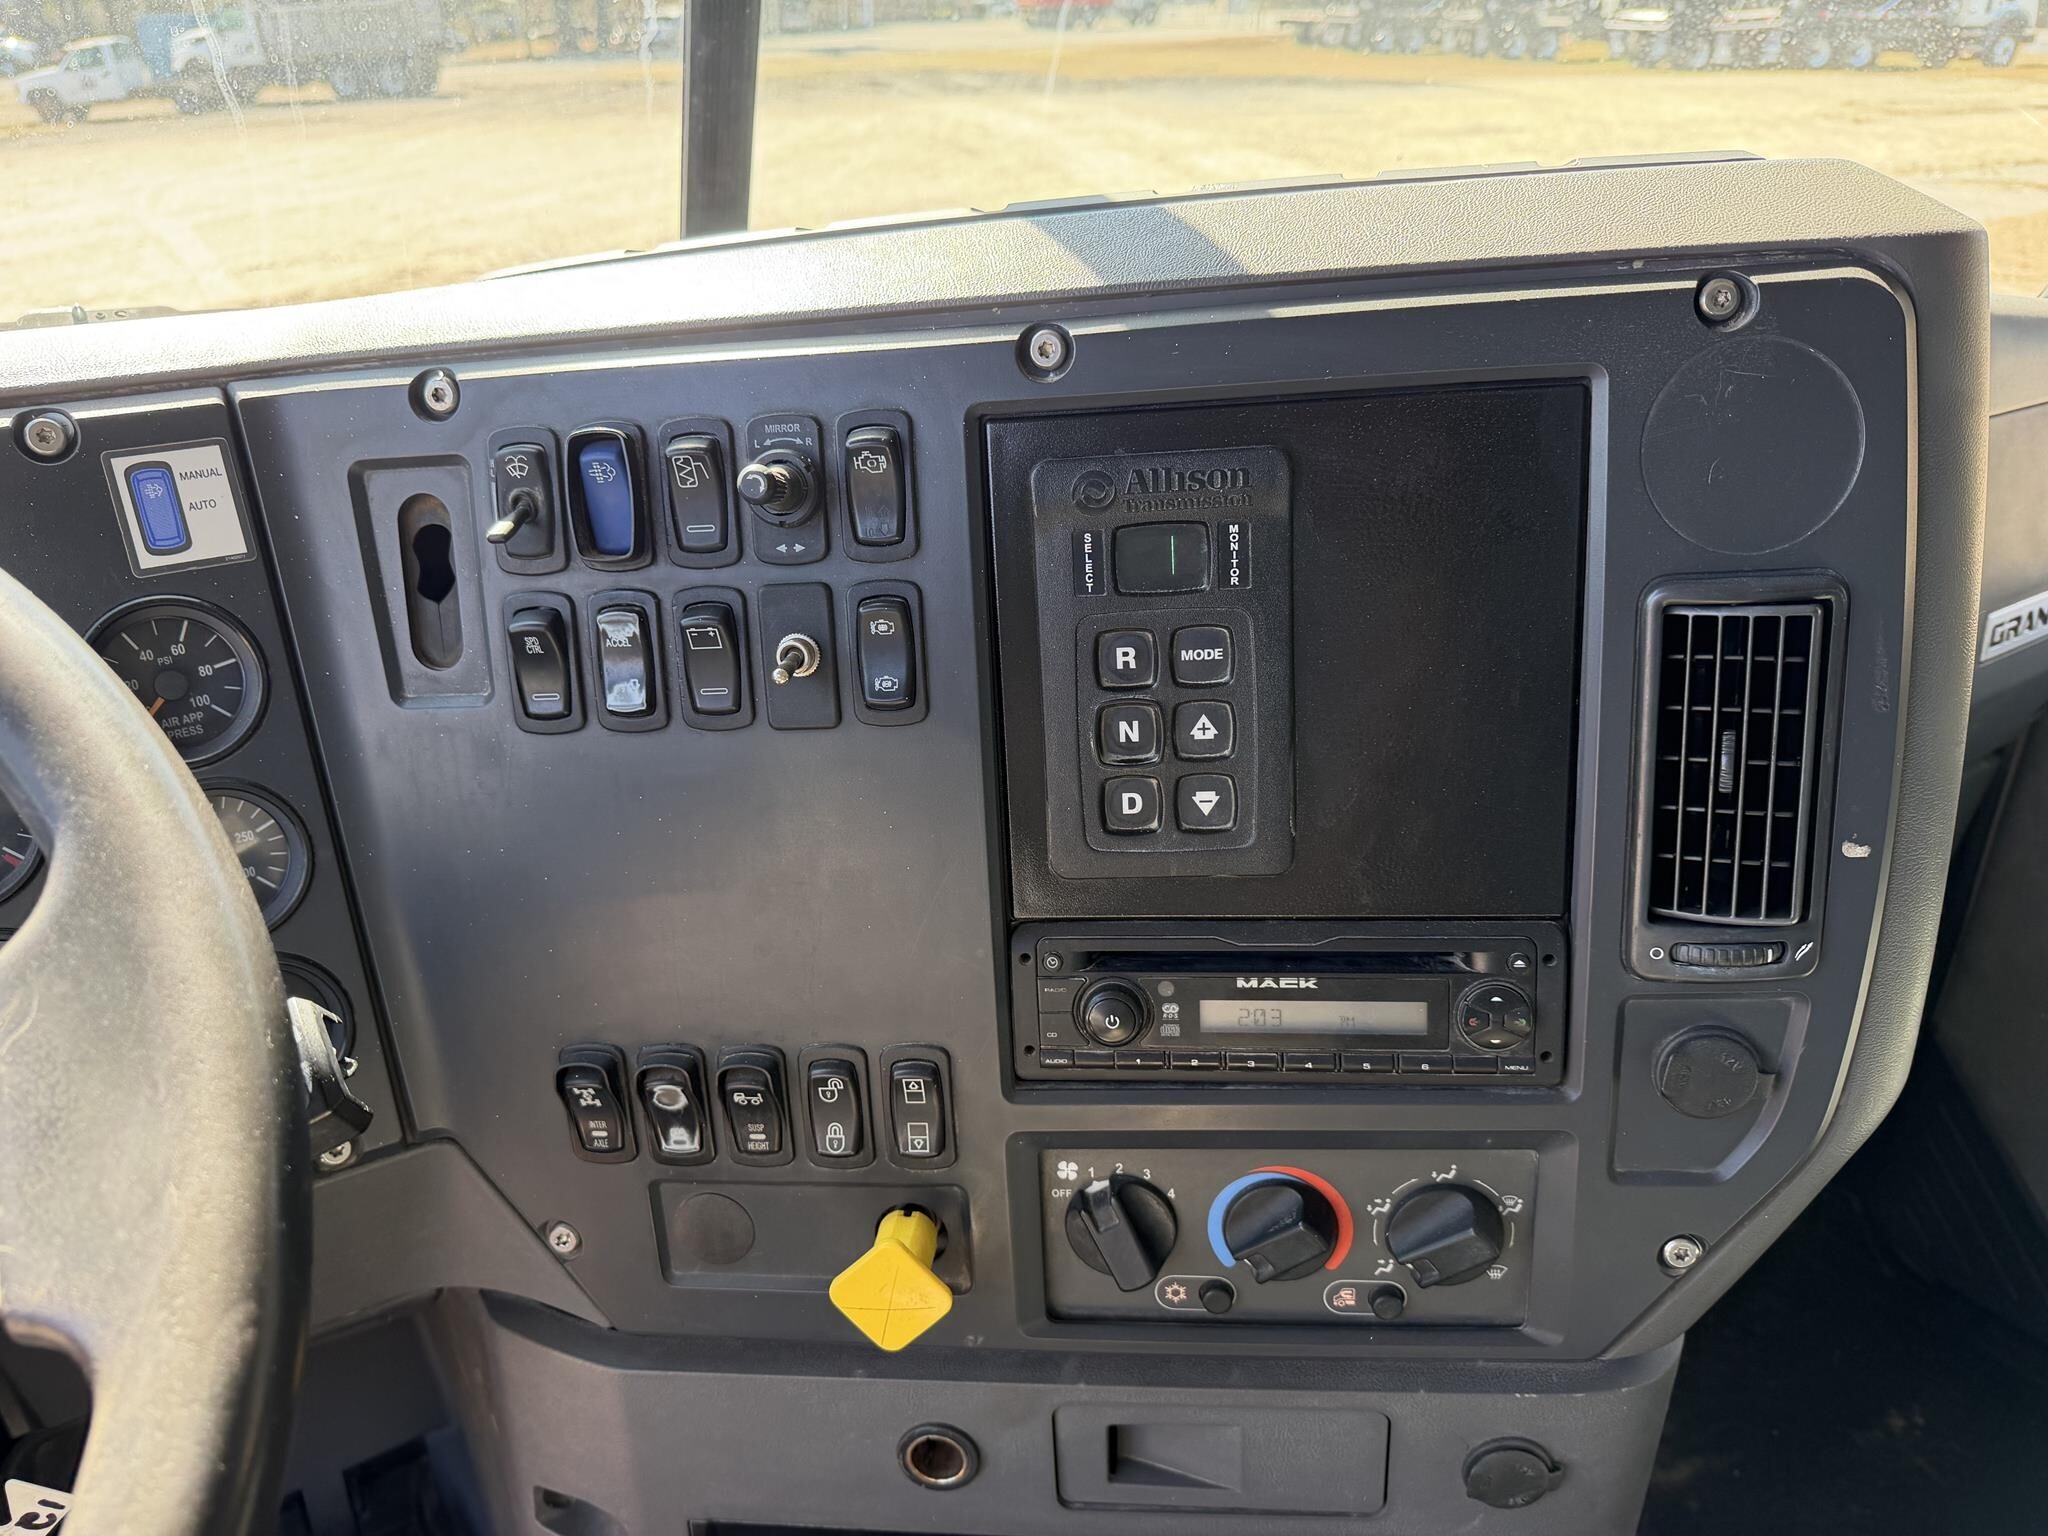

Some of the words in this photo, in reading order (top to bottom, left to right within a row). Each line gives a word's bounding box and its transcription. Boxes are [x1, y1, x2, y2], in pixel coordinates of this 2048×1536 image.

[764, 423, 801, 433] MIRROR
[754, 439, 760, 449] L
[805, 437, 813, 446] R
[179, 467, 223, 481] MANUAL
[1125, 467, 1251, 494] Allison
[188, 498, 217, 511] AUTO
[1228, 524, 1239, 586] MONITOR
[1083, 533, 1094, 593] SELECT
[524, 636, 540, 646] SPD
[605, 638, 632, 648] ACCEL
[139, 649, 154, 661] 40
[170, 643, 186, 656] 60
[525, 645, 544, 654] CTRL
[1180, 648, 1224, 661] MODE
[157, 656, 173, 666] PSI
[1115, 647, 1137, 670] R
[198, 665, 213, 677] 80
[189, 694, 210, 708] 100
[161, 716, 181, 729] AIR
[182, 711, 204, 725] APP
[167, 725, 204, 739] PRESS
[1118, 720, 1140, 743] N
[1121, 792, 1143, 815] D
[233, 830, 254, 844] 250
[1236, 977, 1318, 989] MACK
[747, 1123, 765, 1132] SUSP
[594, 1138, 609, 1148] AXLE
[1088, 1166, 1095, 1178] 1
[1115, 1162, 1124, 1174] 2
[1143, 1168, 1151, 1180] 3
[1051, 1189, 1072, 1198] OFF
[1167, 1188, 1176, 1199] 4
